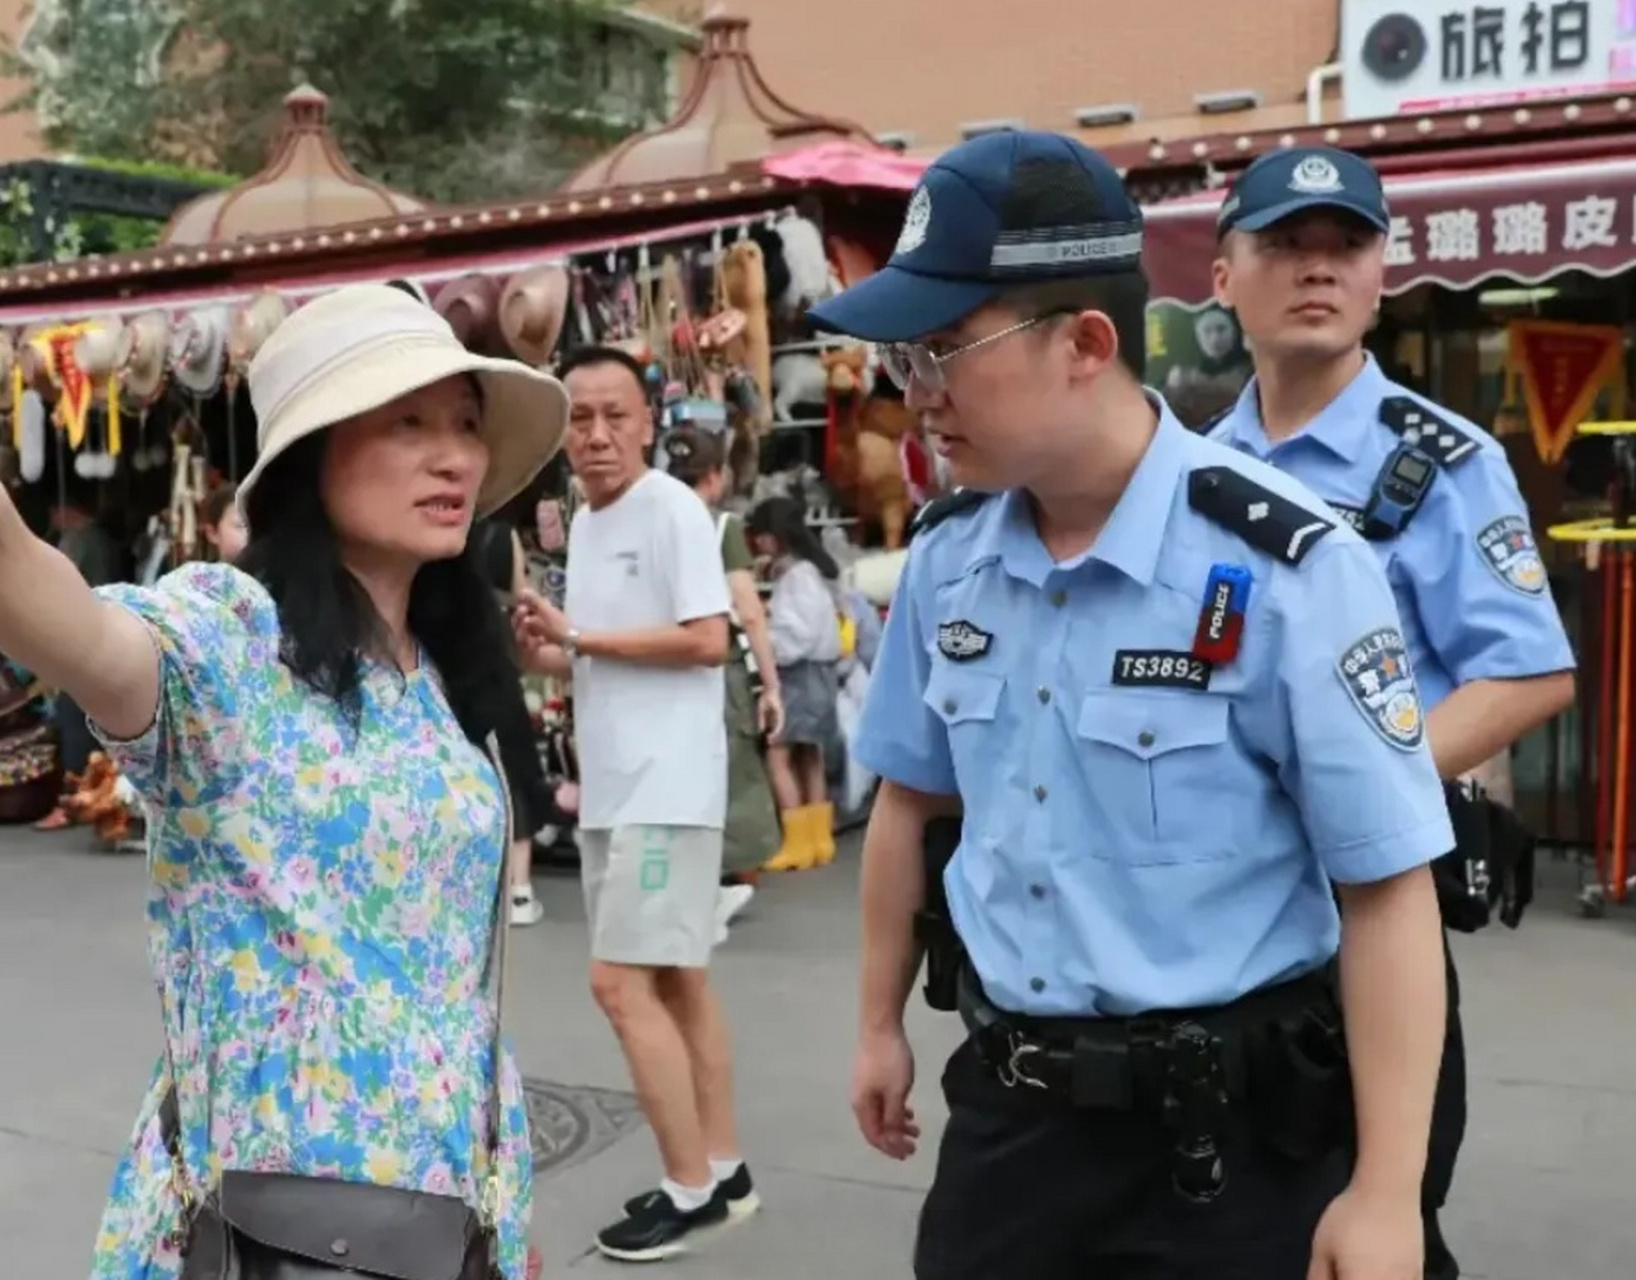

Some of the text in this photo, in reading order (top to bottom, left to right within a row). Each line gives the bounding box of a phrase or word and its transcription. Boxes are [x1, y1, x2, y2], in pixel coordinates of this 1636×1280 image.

[1440, 1, 1591, 80] 旅拍
[1382, 194, 1636, 265] 璐璐皮
[1209, 583, 1230, 639] POLICE
[1121, 656, 1204, 681] TS3892
